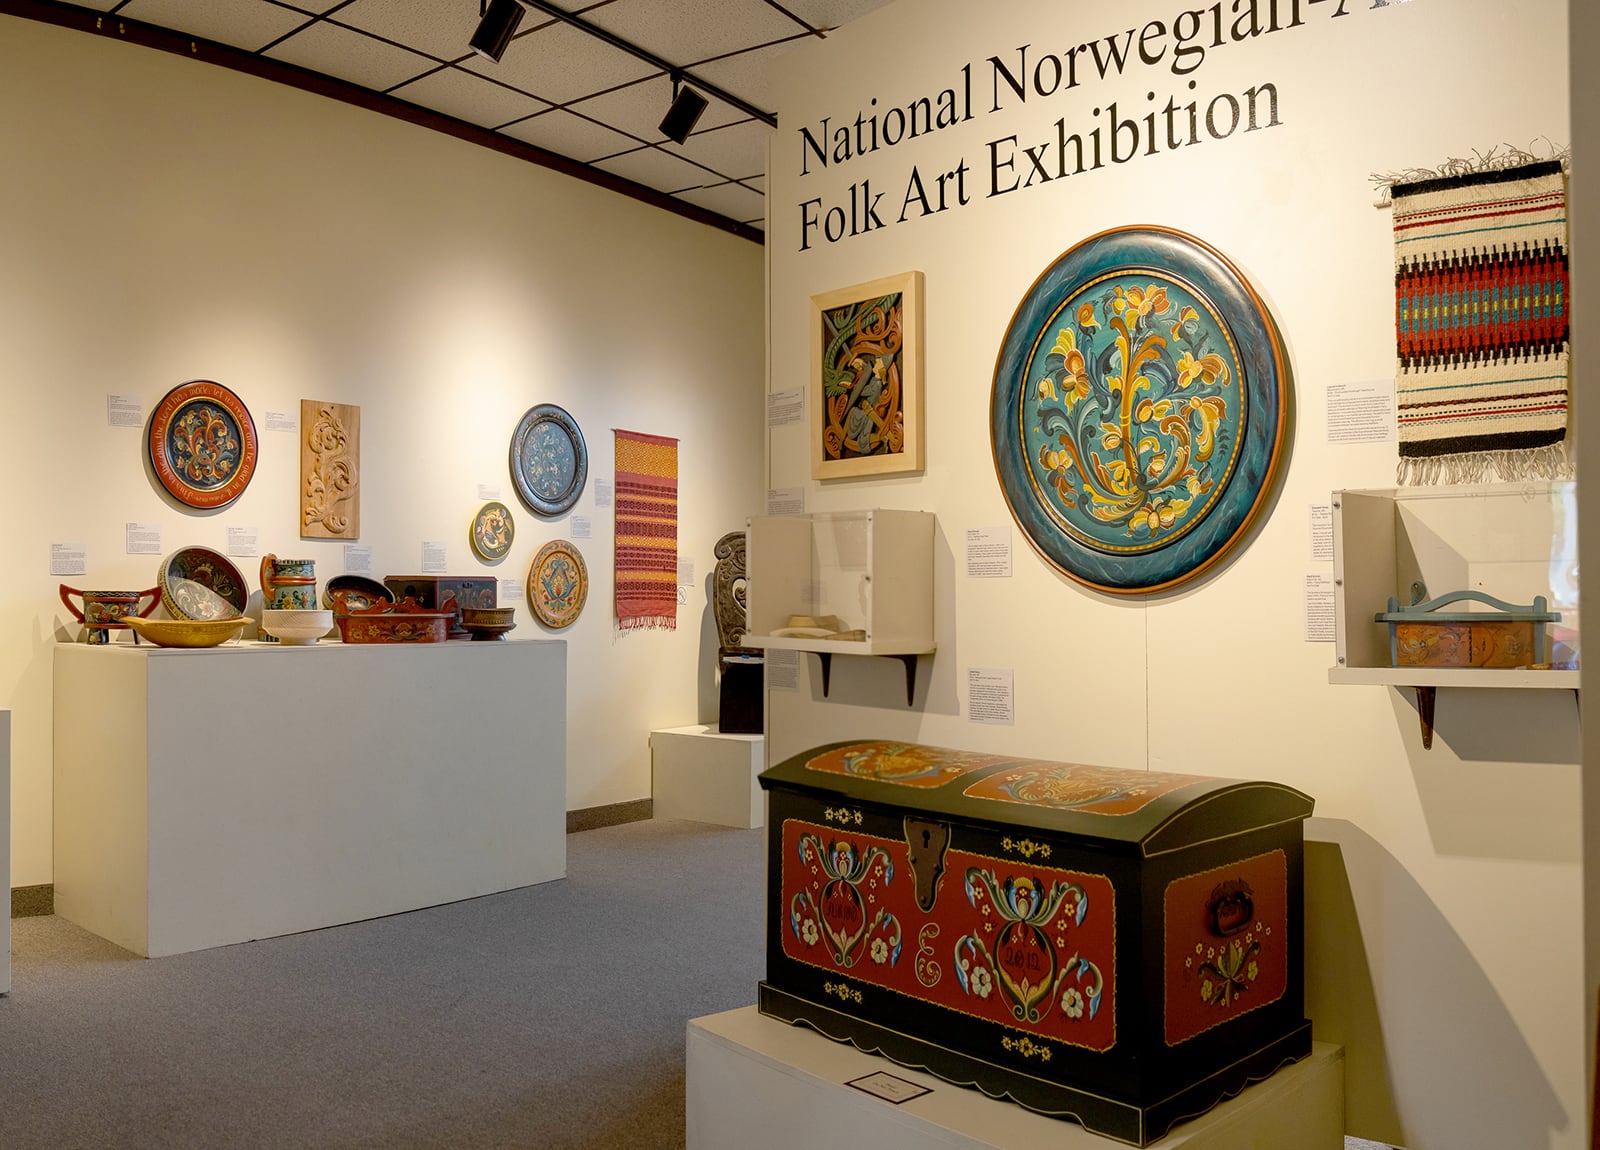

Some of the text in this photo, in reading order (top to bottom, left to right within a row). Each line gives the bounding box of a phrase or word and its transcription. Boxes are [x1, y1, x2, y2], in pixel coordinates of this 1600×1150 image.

[797, 79, 1284, 252] Folk Art Exhibition
[798, 0, 1392, 176] National Norwegian-
[1004, 946, 1041, 972] 2012
